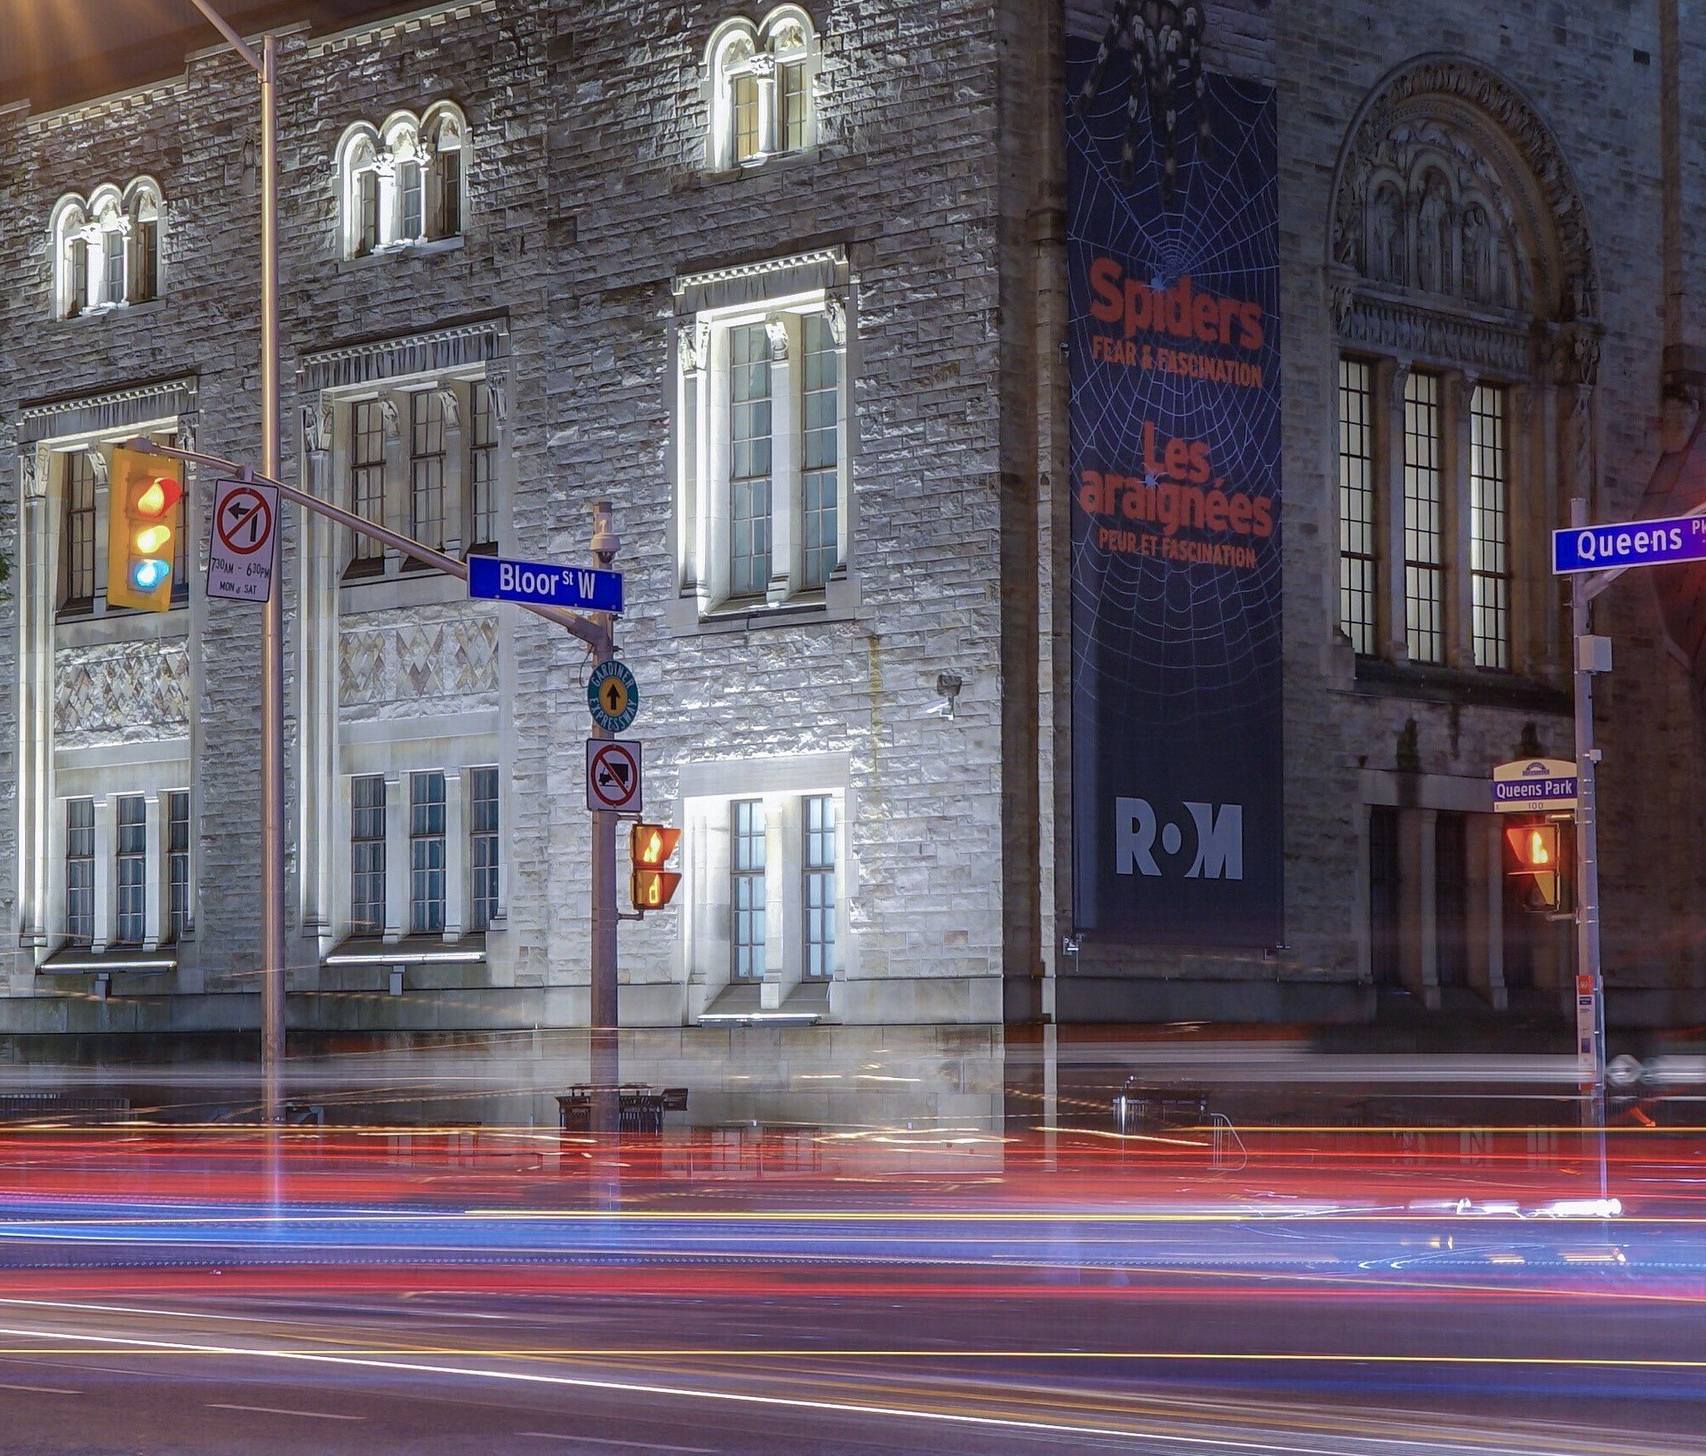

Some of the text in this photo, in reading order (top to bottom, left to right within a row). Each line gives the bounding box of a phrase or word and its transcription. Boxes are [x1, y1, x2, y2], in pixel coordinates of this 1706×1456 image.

[1089, 256, 1264, 350] Spiders
[1092, 335, 1262, 388] FEAR & FASCINATION
[1143, 420, 1211, 483] Les
[1079, 470, 1273, 537] araignées
[1098, 528, 1256, 568] PEUR ET FASCINATION
[1577, 527, 1683, 561] Queens
[219, 580, 235, 592] MON
[243, 584, 257, 595] SAT
[499, 563, 595, 600] Bloor St W
[590, 661, 635, 689] GARDINER
[588, 697, 637, 731] EXPRESSWAY
[1496, 780, 1572, 798] Queens Park
[1528, 802, 1544, 810] 100
[1115, 796, 1243, 880] ROM
